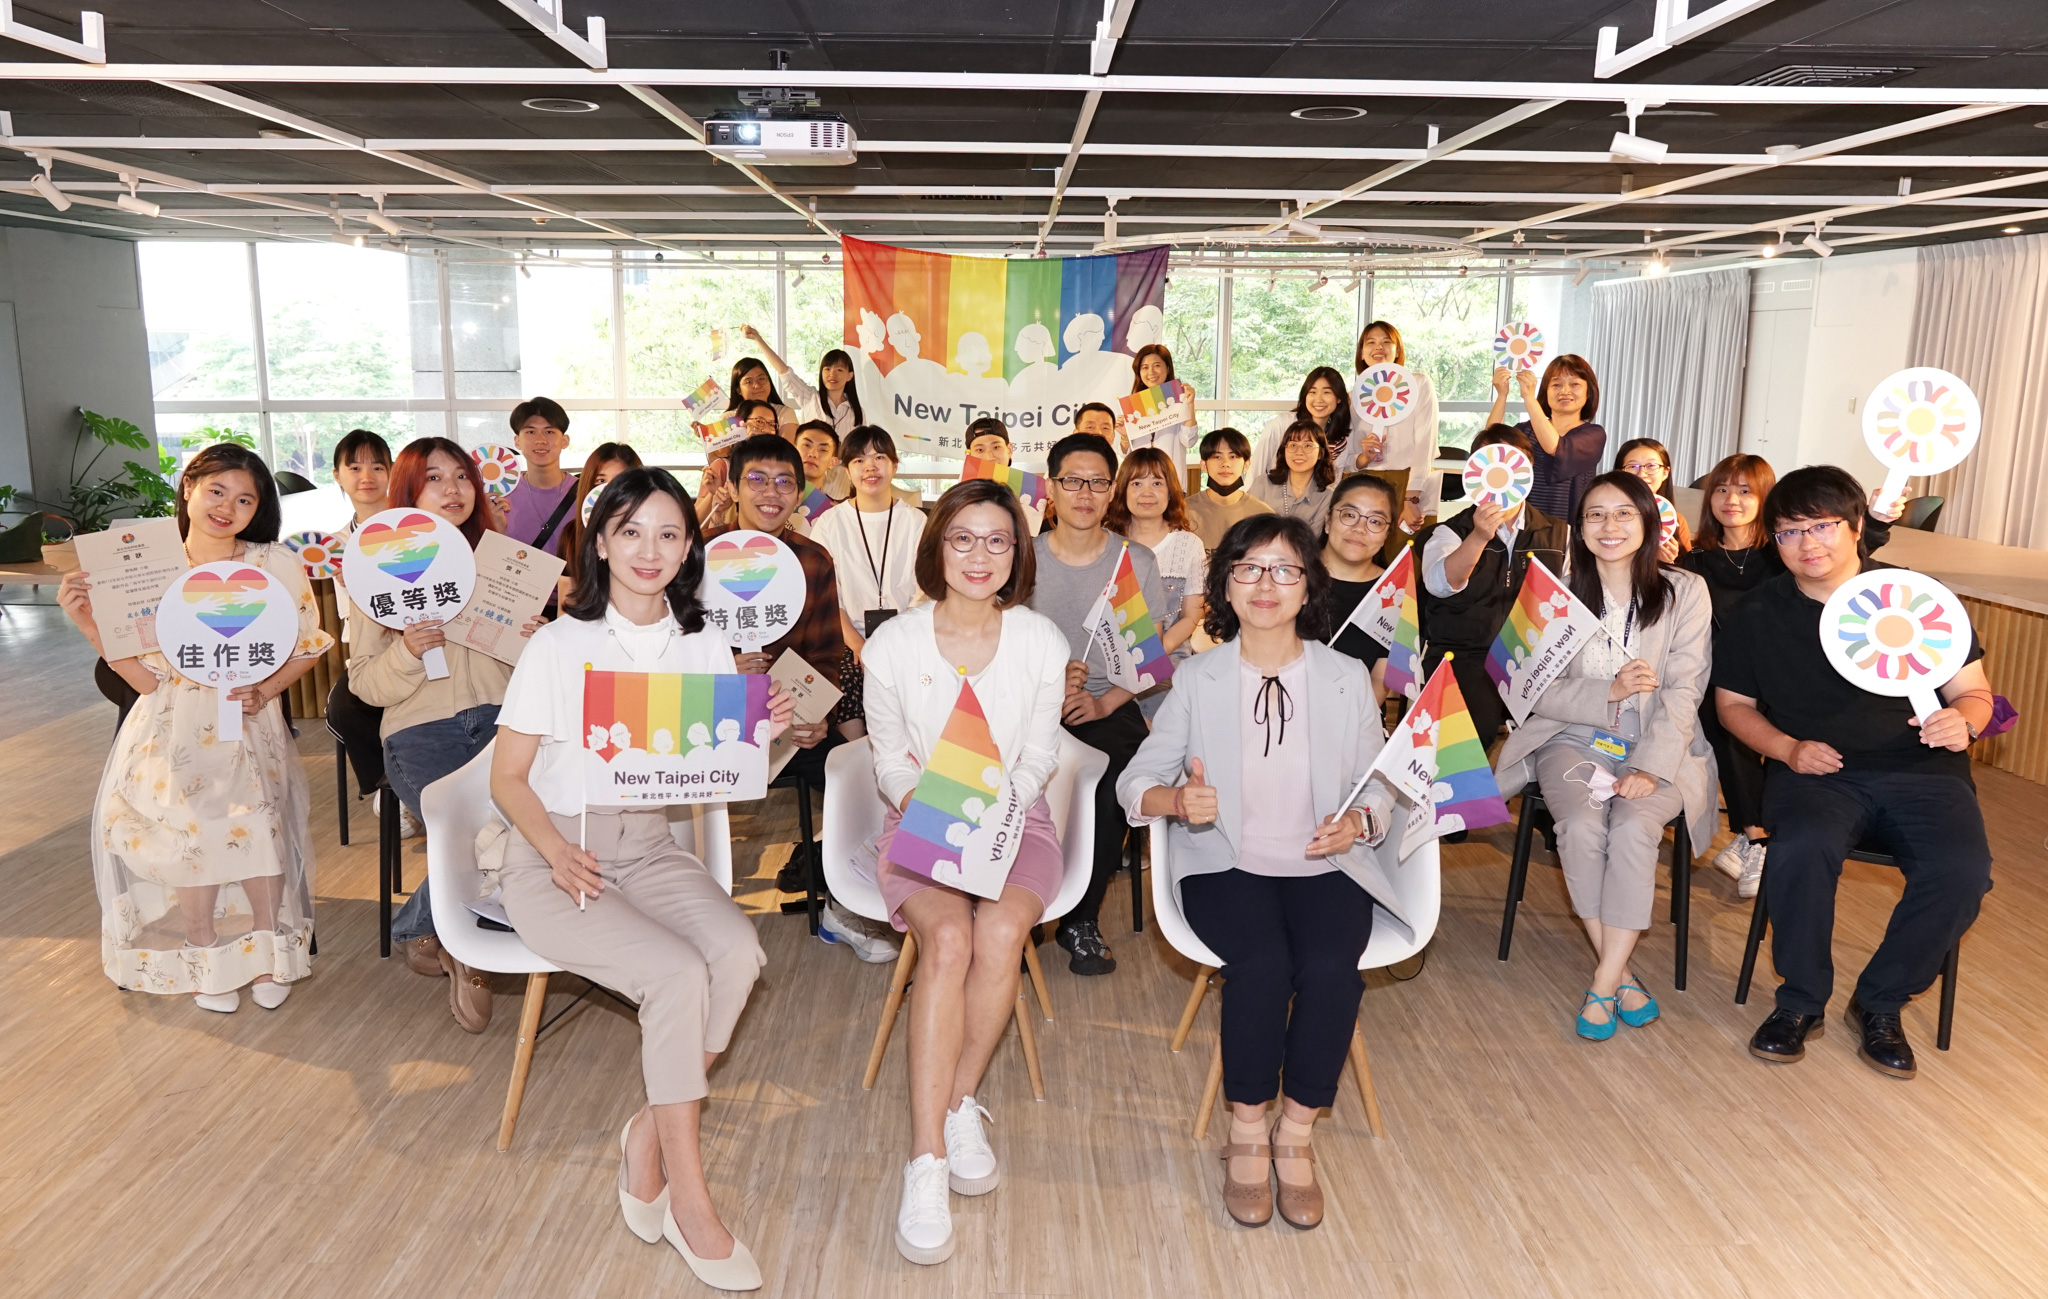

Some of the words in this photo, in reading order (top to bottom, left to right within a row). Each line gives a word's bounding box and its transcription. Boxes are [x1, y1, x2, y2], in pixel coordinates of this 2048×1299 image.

[894, 393, 951, 423] New
[1052, 403, 1086, 426] Ci
[370, 582, 461, 618] 優等獎
[706, 604, 788, 630] 特優獎
[1376, 616, 1394, 632] New
[1101, 620, 1118, 652] Taipei
[176, 642, 276, 669] 佳作獎
[614, 771, 650, 784] New
[655, 771, 705, 787] Taipei
[710, 770, 740, 786] City
[1408, 759, 1433, 788] New
